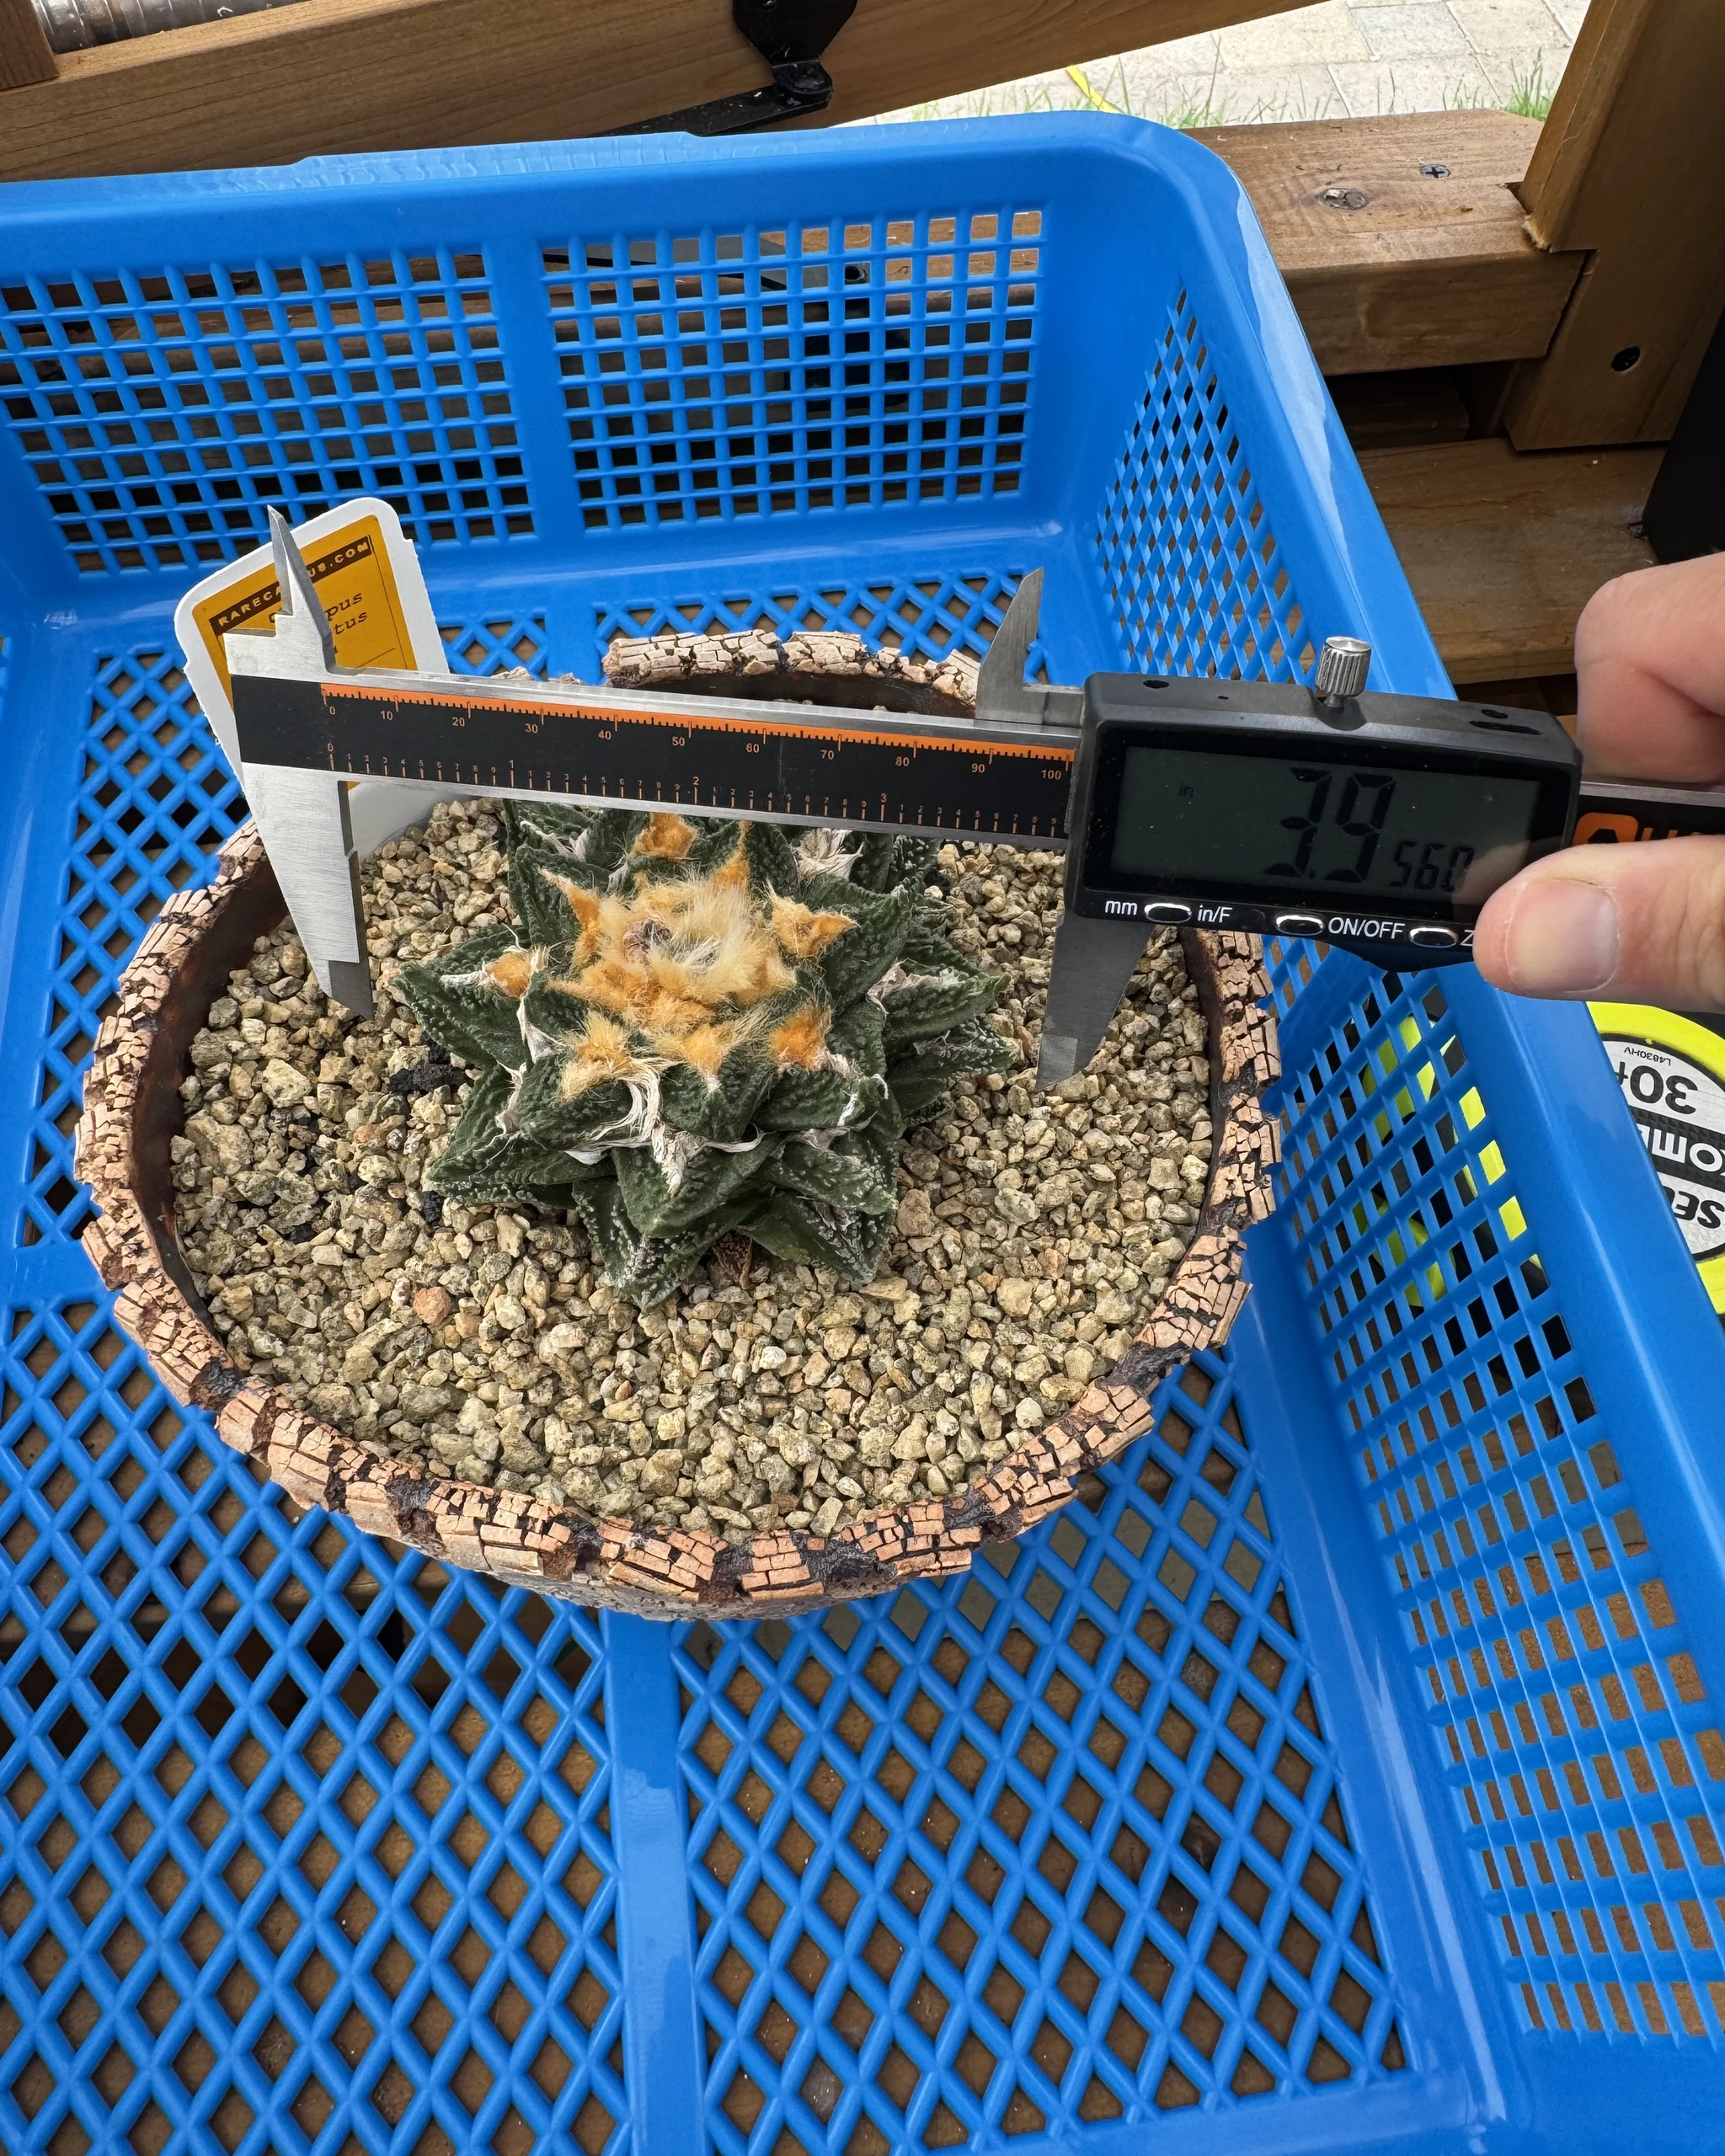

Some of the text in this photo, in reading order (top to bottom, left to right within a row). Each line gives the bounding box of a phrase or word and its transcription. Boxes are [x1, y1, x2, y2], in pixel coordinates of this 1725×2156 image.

[218, 541, 369, 627] RARECUS.COM
[329, 706, 1062, 781] 0 10 20 30 40 50 60 70 80 90 100
[327, 742, 334, 752] 0
[509, 760, 514, 769] 1
[692, 776, 699, 786] 2
[880, 792, 887, 803] 3
[1104, 899, 1138, 916] mm
[1197, 906, 1232, 923] in/F
[1328, 916, 1406, 939] ON/OFF
